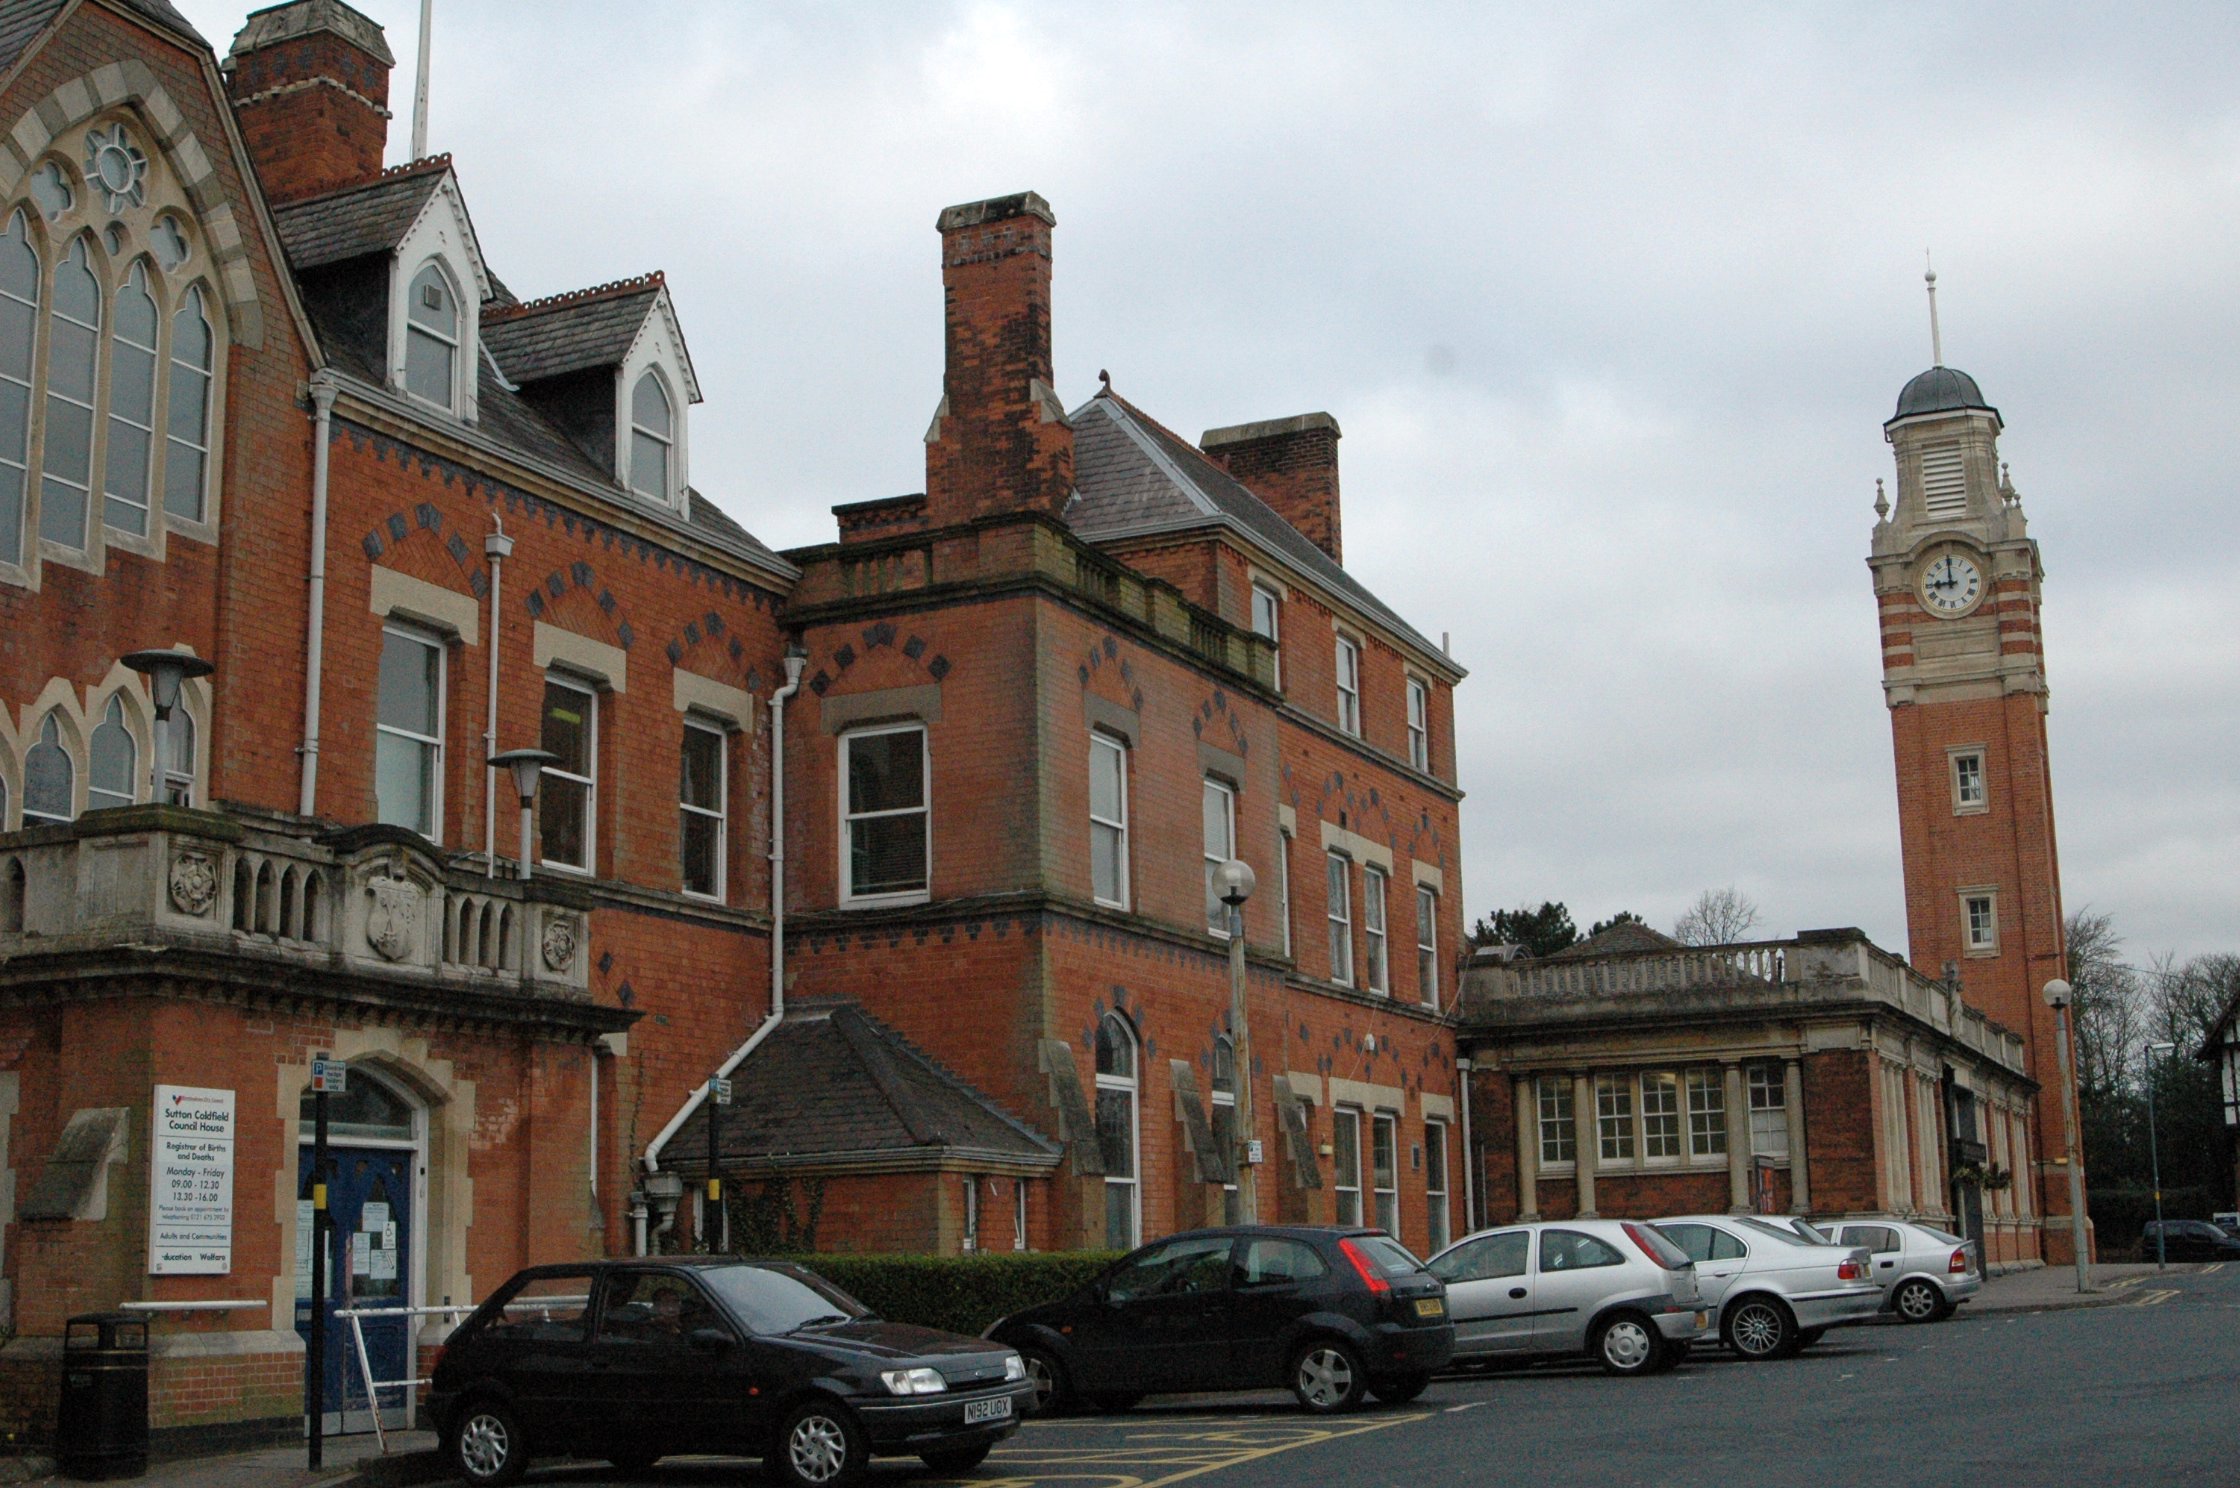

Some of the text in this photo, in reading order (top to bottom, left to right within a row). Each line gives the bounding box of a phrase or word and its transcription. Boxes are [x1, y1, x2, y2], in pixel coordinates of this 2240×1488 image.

[315, 1063, 323, 1074] P
[165, 1108, 229, 1121] Sutton Coldfield
[169, 1120, 225, 1132] Council House
[166, 1142, 197, 1152] Registrar
[208, 1144, 226, 1152] Births
[192, 1153, 215, 1161] Deaths
[166, 1167, 195, 1178] Monday
[203, 1168, 225, 1179] Friday
[171, 1180, 192, 1188] 09.00
[200, 1181, 219, 1189] 12.30
[173, 1192, 193, 1201] 13.30
[160, 1232, 178, 1240] Adults
[967, 1398, 1008, 1420] N192 UOX
